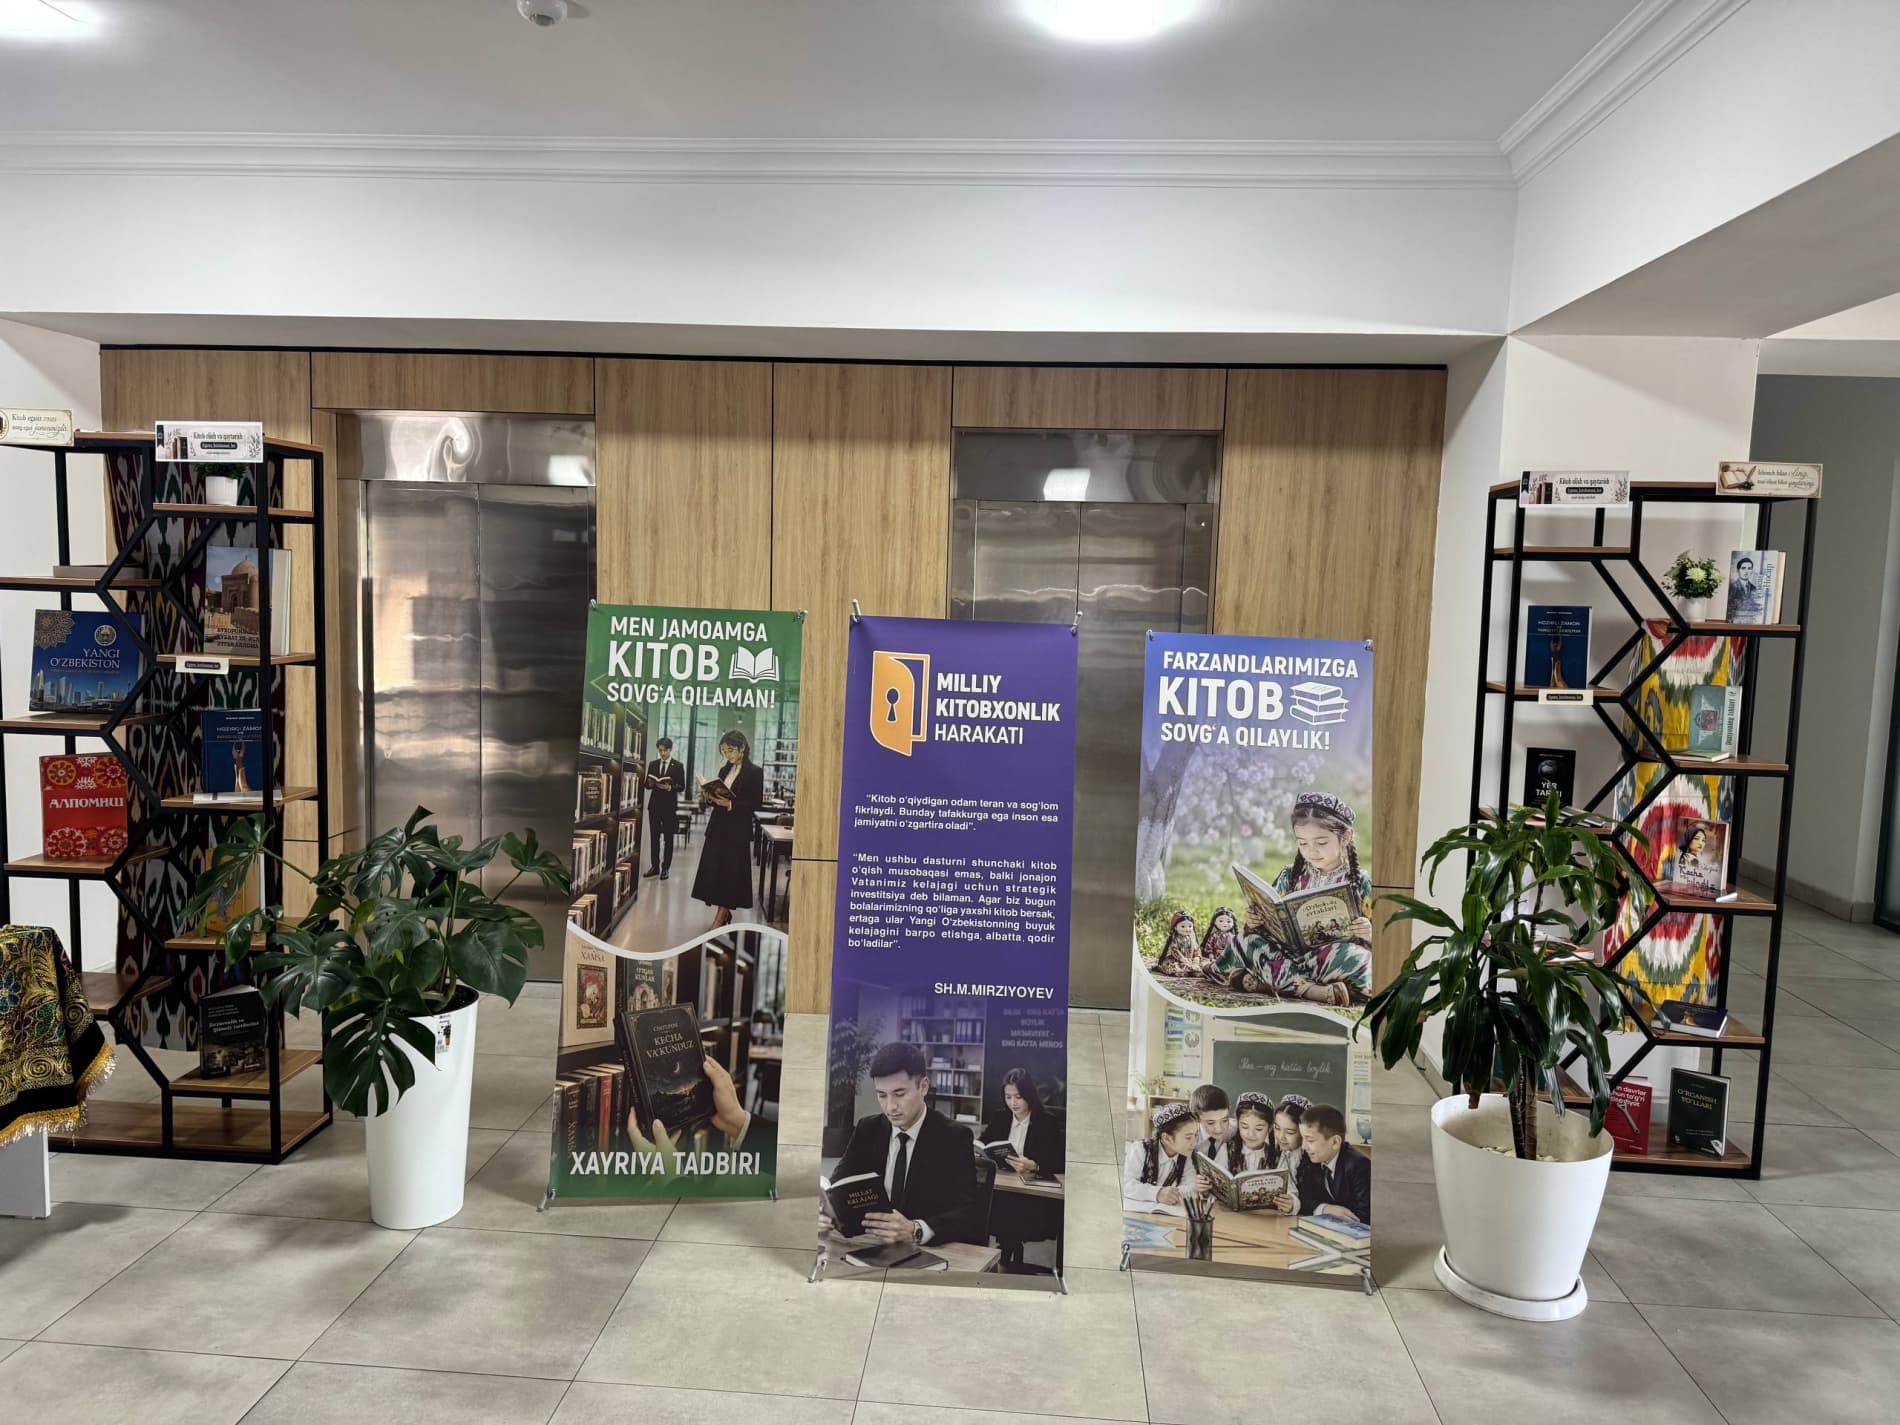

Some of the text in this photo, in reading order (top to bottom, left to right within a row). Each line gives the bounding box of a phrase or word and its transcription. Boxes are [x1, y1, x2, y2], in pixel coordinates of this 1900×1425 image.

[611, 616, 767, 642] MEN JAMOAMGA
[83, 648, 120, 658] YANGI
[608, 640, 719, 681] KITOB
[50, 657, 120, 669] O'ZBEKISTON
[1163, 651, 1359, 678] FARZANDLARIMIZGA
[937, 673, 1002, 693] MILLIY
[607, 683, 775, 708] SOVG'A QILAMAN!
[1158, 676, 1283, 720] KITOB
[936, 698, 1060, 721] KITOBXONLIK
[935, 723, 1023, 744] HARAKATI
[1160, 722, 1330, 750] SOVG'A QILAYLIK!
[49, 797, 124, 808] АЛПОМИШ
[899, 796, 948, 807] o'qiydigan
[951, 798, 977, 806] odam
[980, 800, 1004, 808] teran
[1021, 802, 1058, 811] sog'lom
[855, 806, 896, 816] fikrlaydi.
[900, 808, 935, 818] Bunday
[939, 810, 988, 821] tafakkurga
[992, 813, 1008, 821] ega
[1012, 813, 1038, 821] inson
[855, 818, 897, 828] jamiyatni
[899, 820, 943, 830] o'zgartira
[886, 855, 917, 864] ushbu
[923, 857, 965, 866] dasturni
[972, 858, 1024, 868] shunchaki
[1031, 861, 1057, 870] kitob
[852, 866, 1056, 883] o'qish musobaqasi emas, balki jonajon
[852, 878, 1056, 895] Vatanimiz kelajagi uchun strategik
[851, 890, 1055, 908] investitsiya deb bilaman. Agar biz bugun
[850, 902, 1055, 919] bolalarimizning qo'liga yaxshi kitob bersak,
[849, 915, 1055, 932] ertaga ular Yangi O'zbekistonning buyuk
[849, 927, 1055, 944] kelajagini barpo etishga, albatta, qodir
[934, 982, 1054, 999] SH.M.MIRZIYOYEV
[654, 1033, 683, 1046] KECHA
[1623, 1087, 1647, 1096] davrlar
[570, 1151, 760, 1175] XAYRIYA TADBIRI
